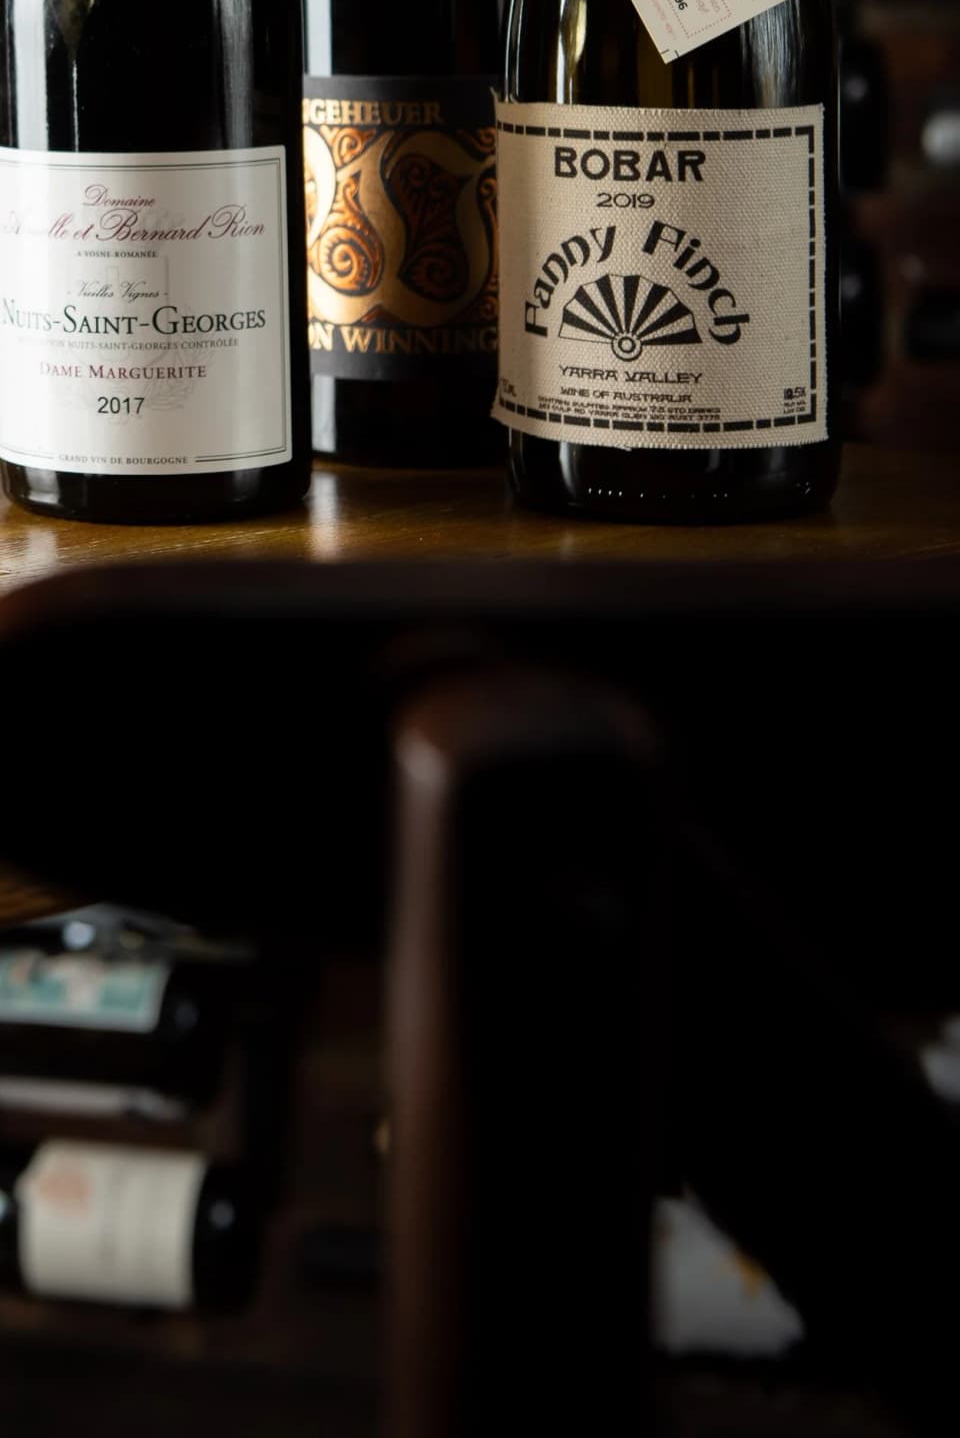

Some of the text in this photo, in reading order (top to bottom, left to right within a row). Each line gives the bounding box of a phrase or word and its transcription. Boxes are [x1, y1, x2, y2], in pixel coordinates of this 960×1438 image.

[302, 98, 444, 125] GEHEUER
[554, 146, 706, 182] BOBAR
[82, 184, 155, 207] Domaine
[596, 192, 656, 208] 2019
[3, 204, 265, 242] Alle et Bernard Rion
[77, 281, 160, 302] Vieilles Vignes
[524, 220, 750, 345] Fanny Finch
[181, 337, 239, 350] CONTRÔLÉE
[340, 325, 497, 355] WINNING
[89, 364, 207, 379] MARGUERITE
[559, 365, 703, 384] YARRA VALLEY
[560, 386, 693, 403] WINE OF AUSTRALIA
[97, 396, 145, 416] 2017
[58, 453, 189, 465] GRAND VIN DE BOURGOGNE
